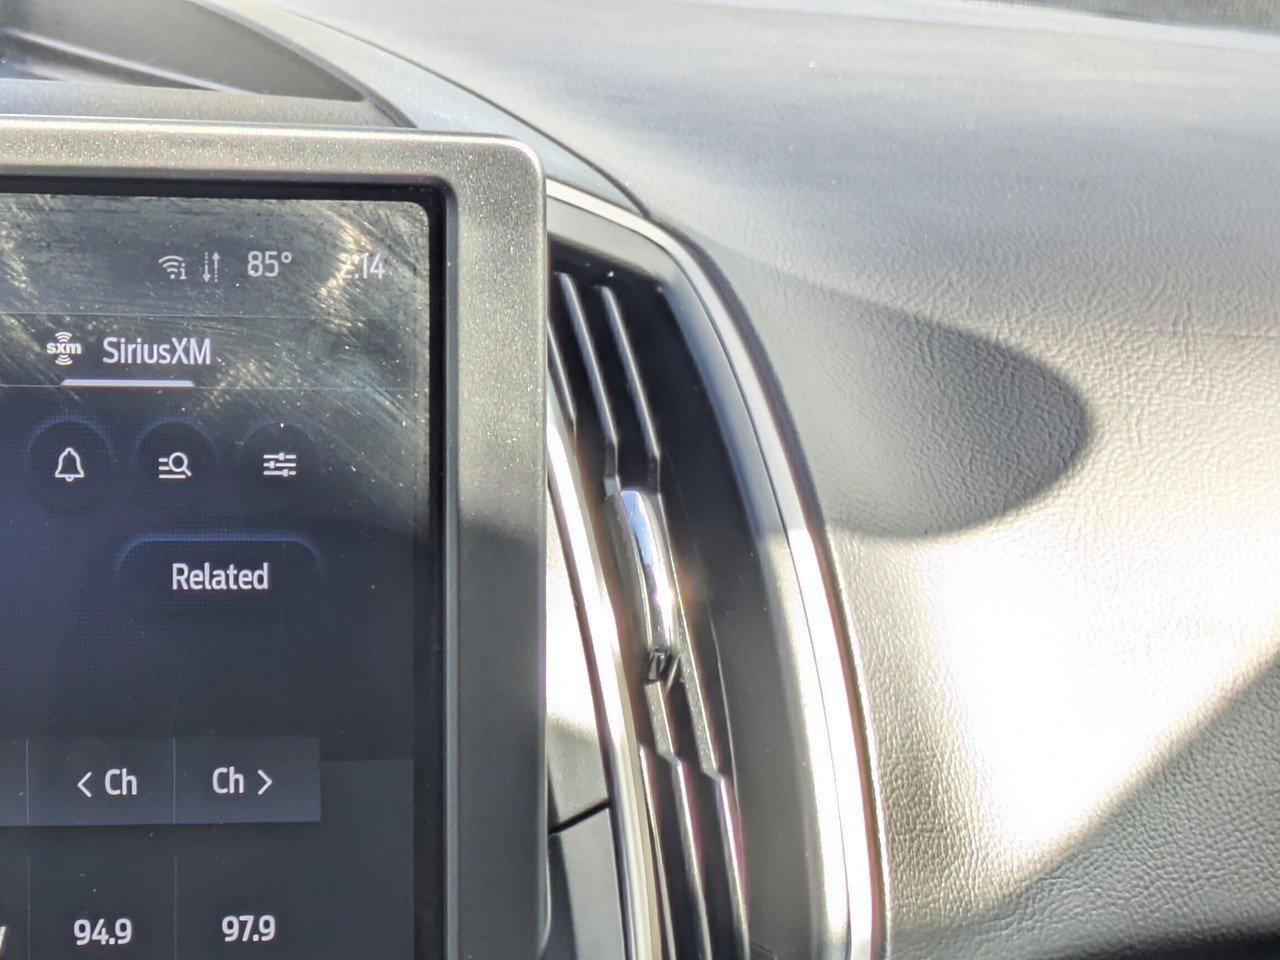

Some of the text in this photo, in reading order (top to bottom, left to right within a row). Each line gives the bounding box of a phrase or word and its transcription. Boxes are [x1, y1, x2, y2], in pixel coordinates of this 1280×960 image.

[247, 250, 293, 278] 85°
[102, 335, 213, 366] SiriusXM
[171, 561, 270, 591] Related
[104, 768, 138, 796] Ch
[211, 766, 245, 794] Ch
[73, 917, 133, 946] 94.9
[221, 914, 276, 943] 97.9
